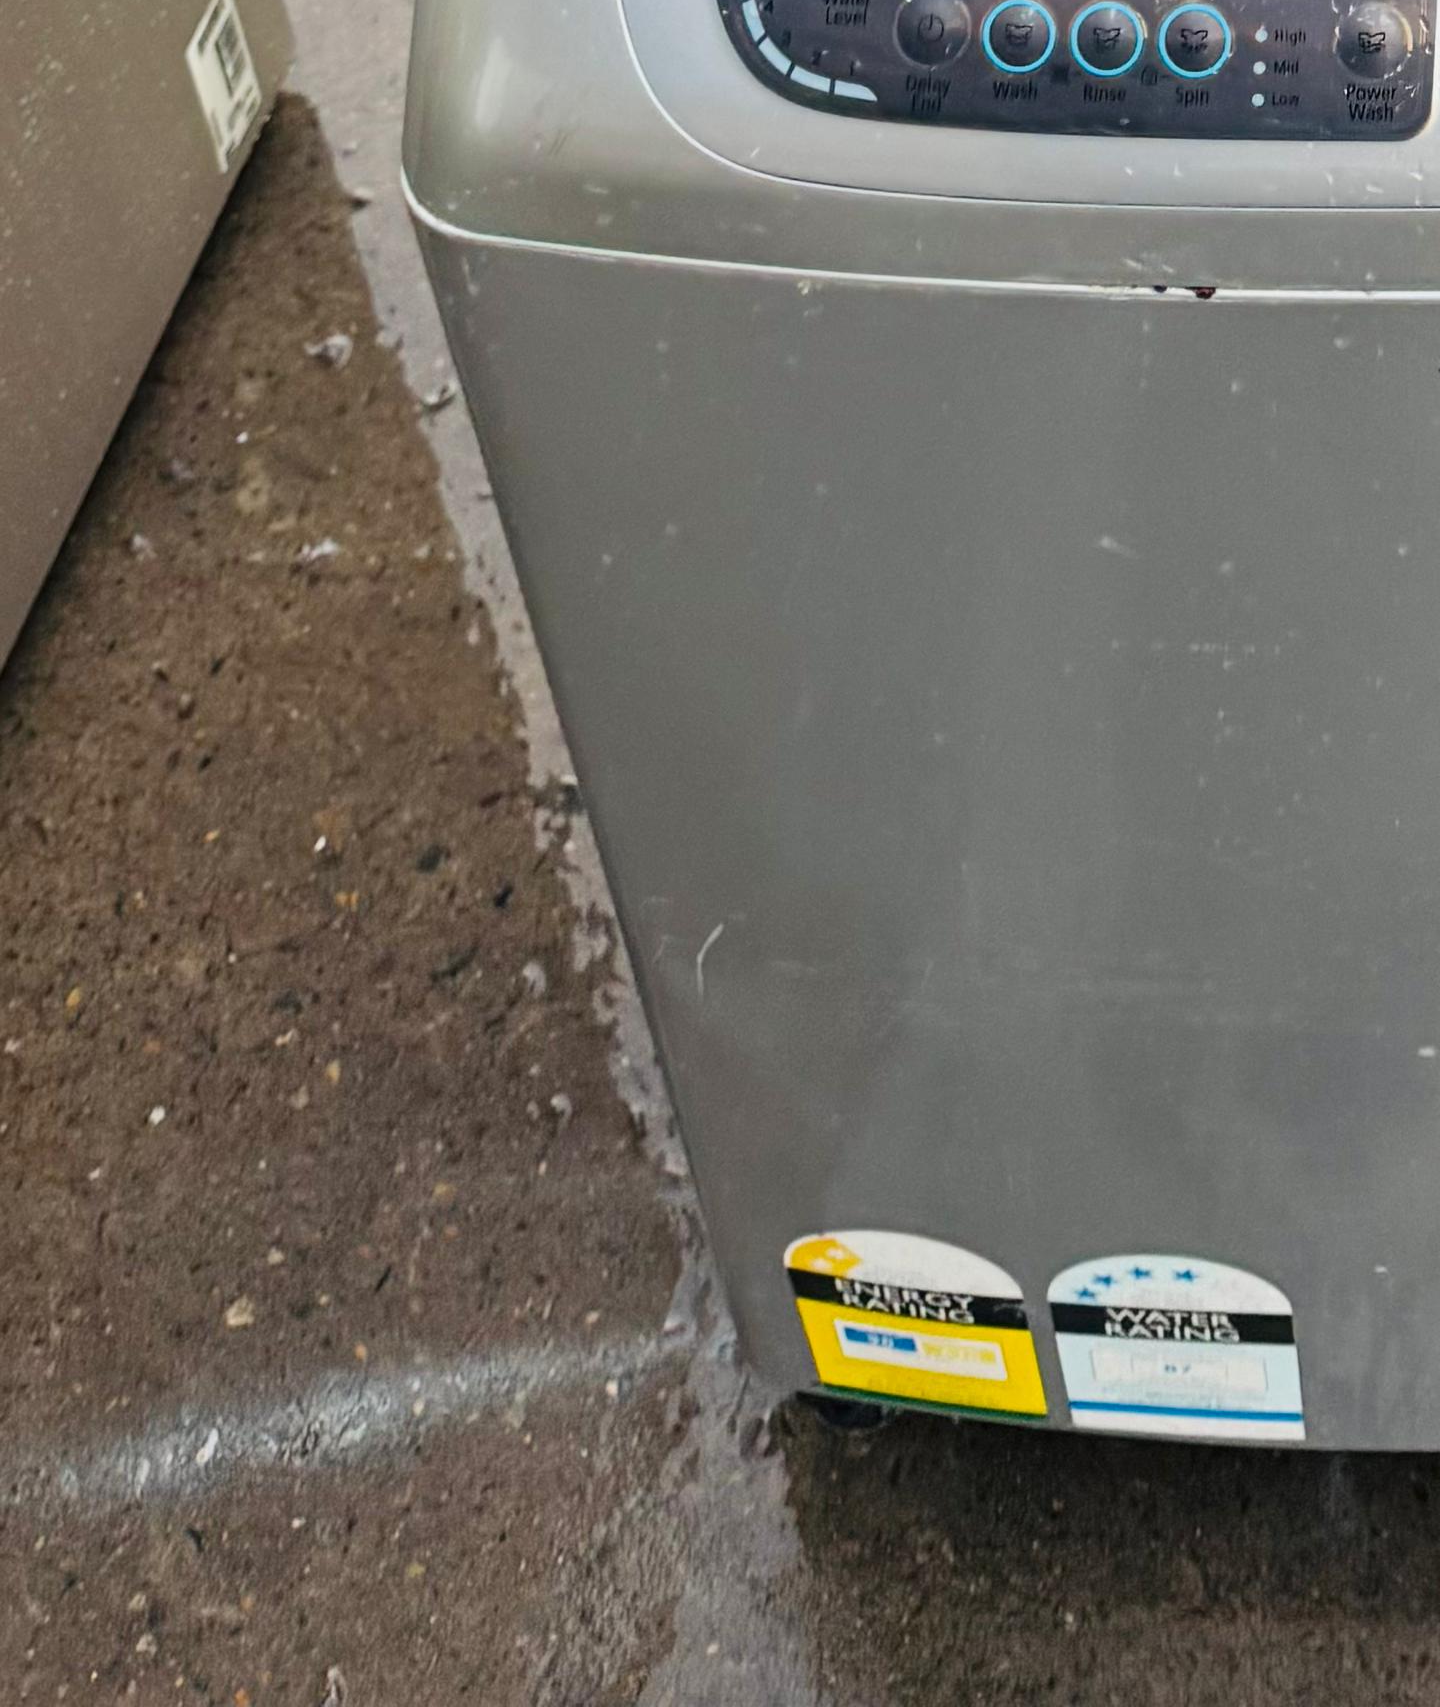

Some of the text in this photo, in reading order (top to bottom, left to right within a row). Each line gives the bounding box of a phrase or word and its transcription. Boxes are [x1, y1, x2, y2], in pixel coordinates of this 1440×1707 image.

[826, 6, 868, 26] Level
[1346, 83, 1398, 102] Power
[1349, 102, 1395, 123] Wash
[834, 1276, 976, 1308] ENERGY
[841, 1292, 976, 1325] RATING
[1105, 1306, 1233, 1327] WATER
[1103, 1320, 1241, 1344] RATING
